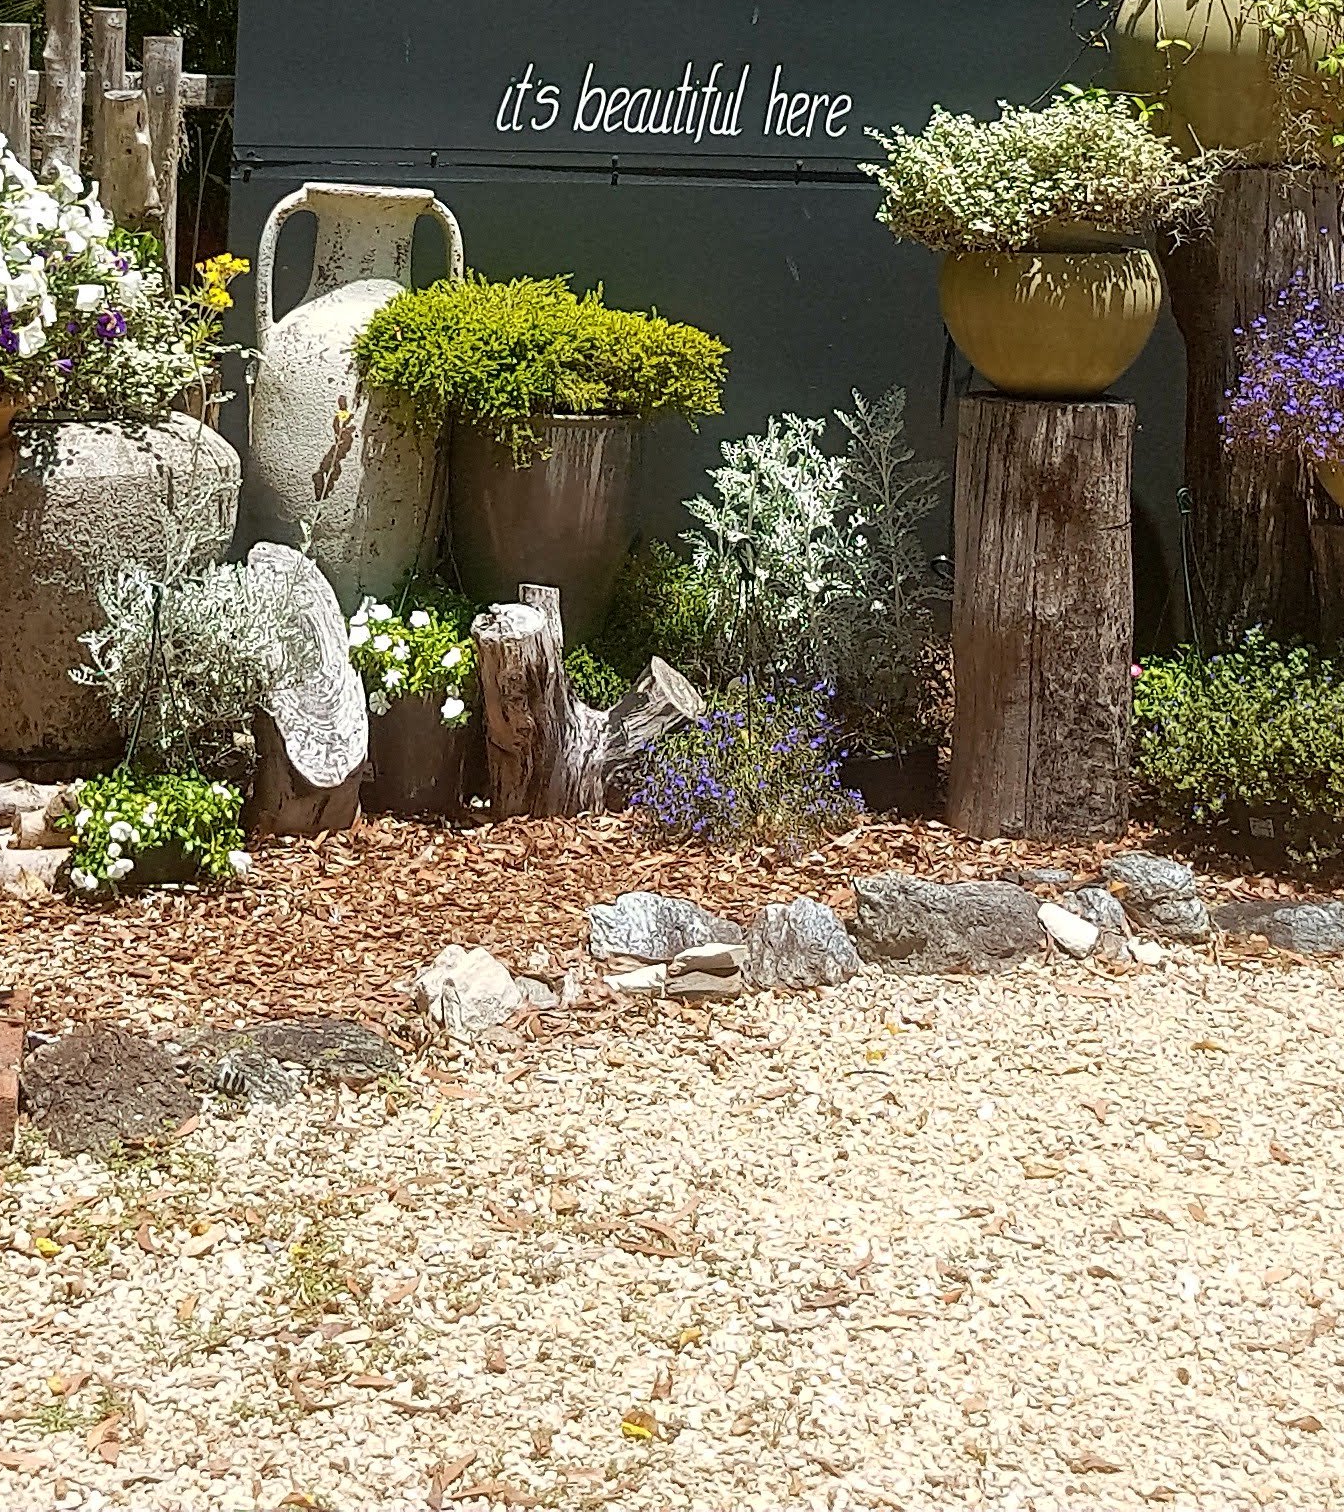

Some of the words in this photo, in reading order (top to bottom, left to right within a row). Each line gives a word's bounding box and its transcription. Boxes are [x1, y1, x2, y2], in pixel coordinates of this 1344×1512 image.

[495, 62, 561, 133] it's
[572, 61, 751, 144] beautiful
[763, 64, 853, 139] here
